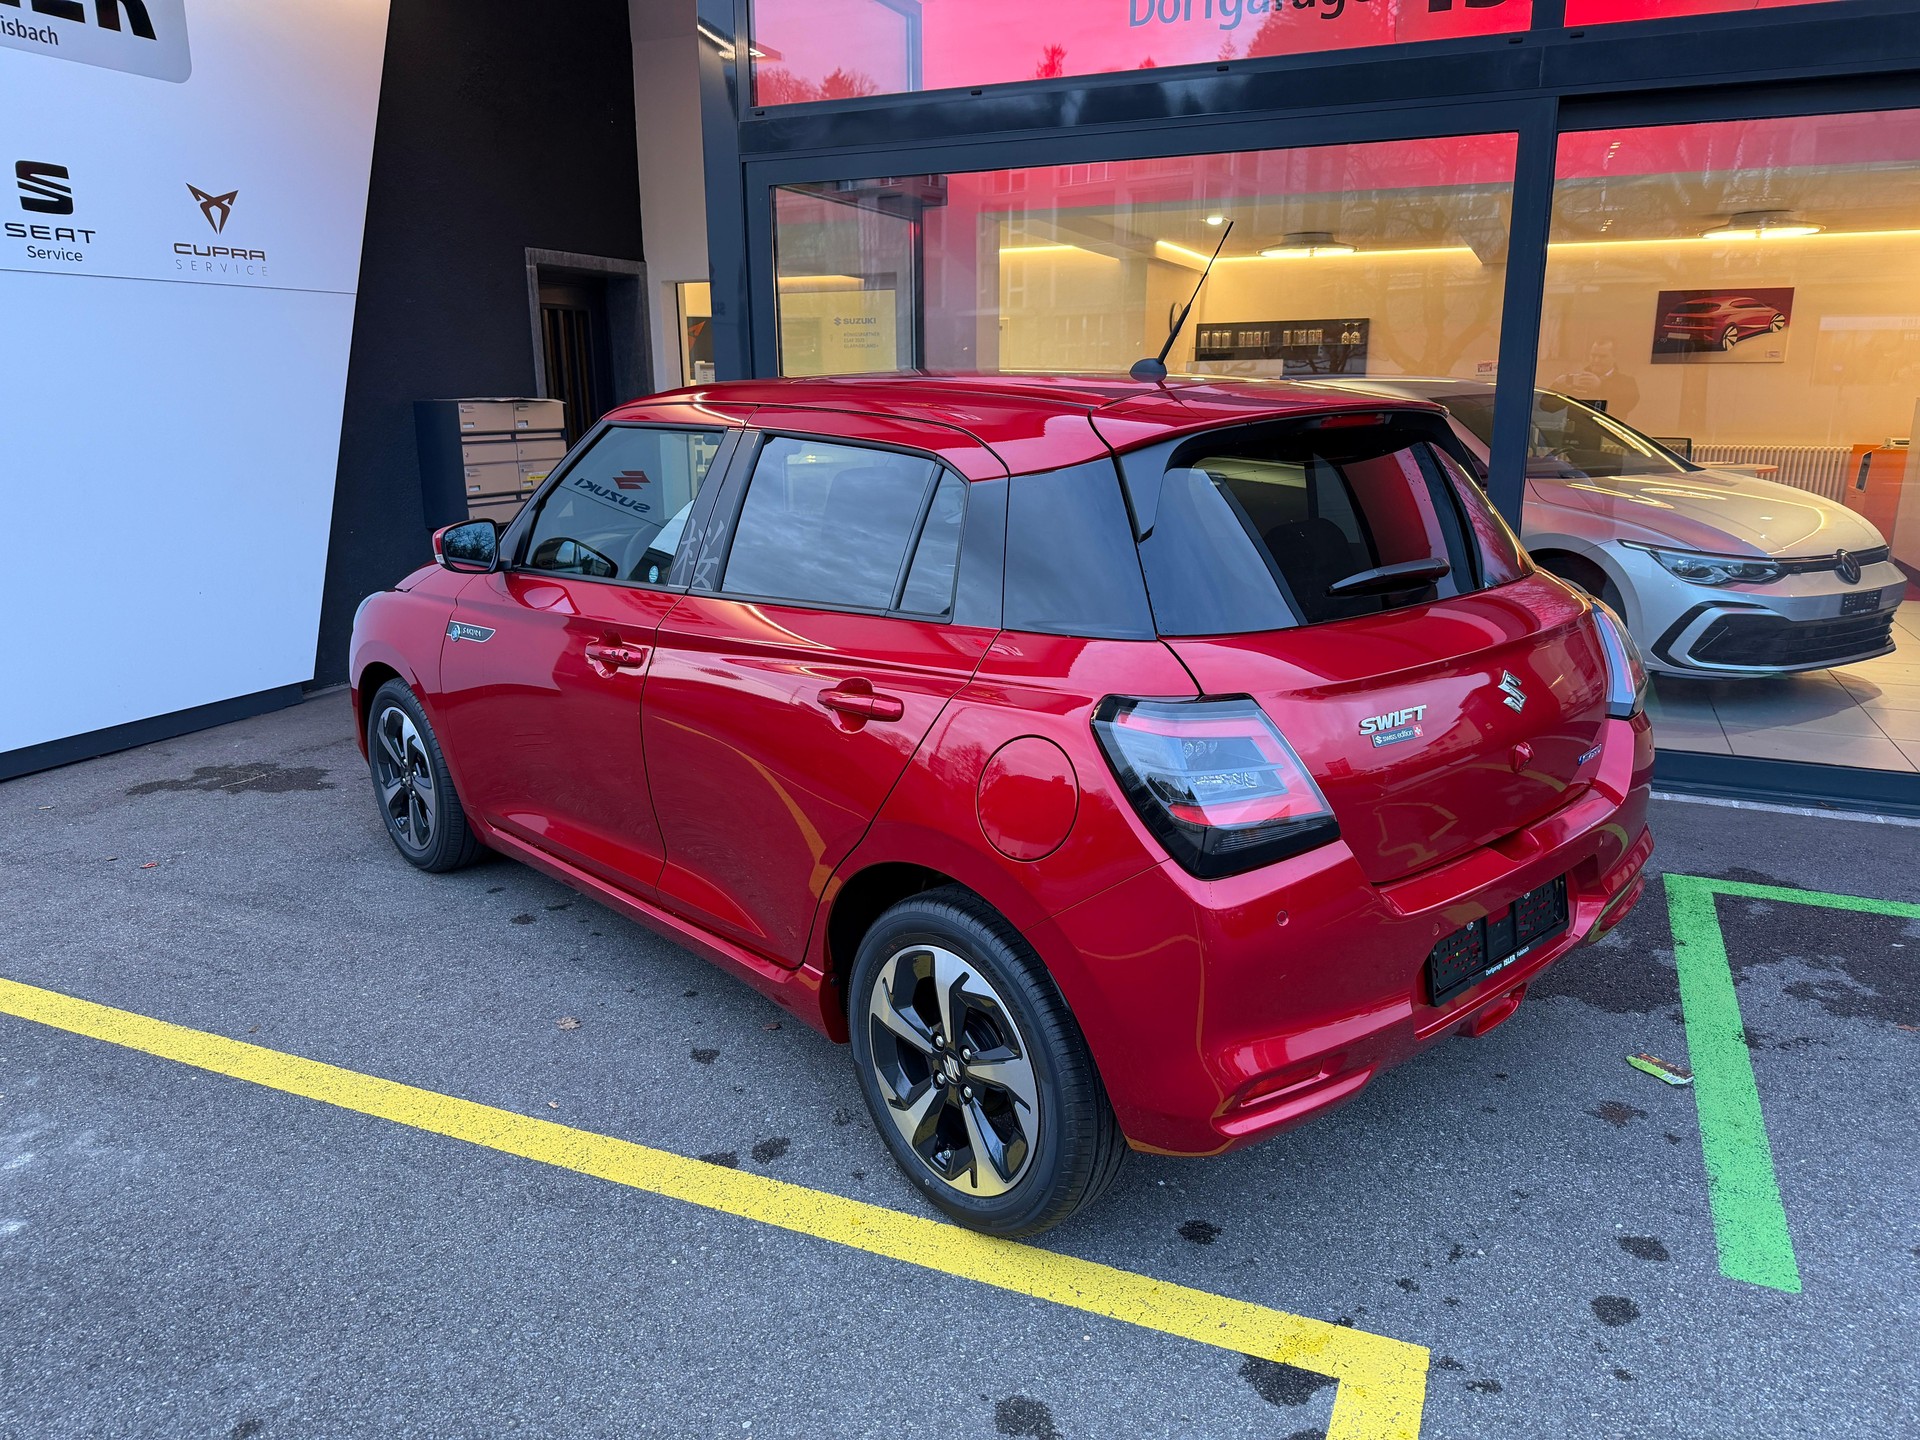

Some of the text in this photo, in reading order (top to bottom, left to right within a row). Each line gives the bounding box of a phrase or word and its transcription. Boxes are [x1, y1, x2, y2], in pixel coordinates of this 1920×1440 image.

[4, 223, 96, 244] SEAT
[26, 245, 83, 262] Service
[173, 242, 266, 262] CUPRA
[175, 259, 268, 277] SERVICE
[843, 317, 877, 325] SUZUKI
[673, 518, 725, 589] 桜
[1359, 704, 1427, 735] SWIFT
[1382, 733, 1398, 742] swiss
